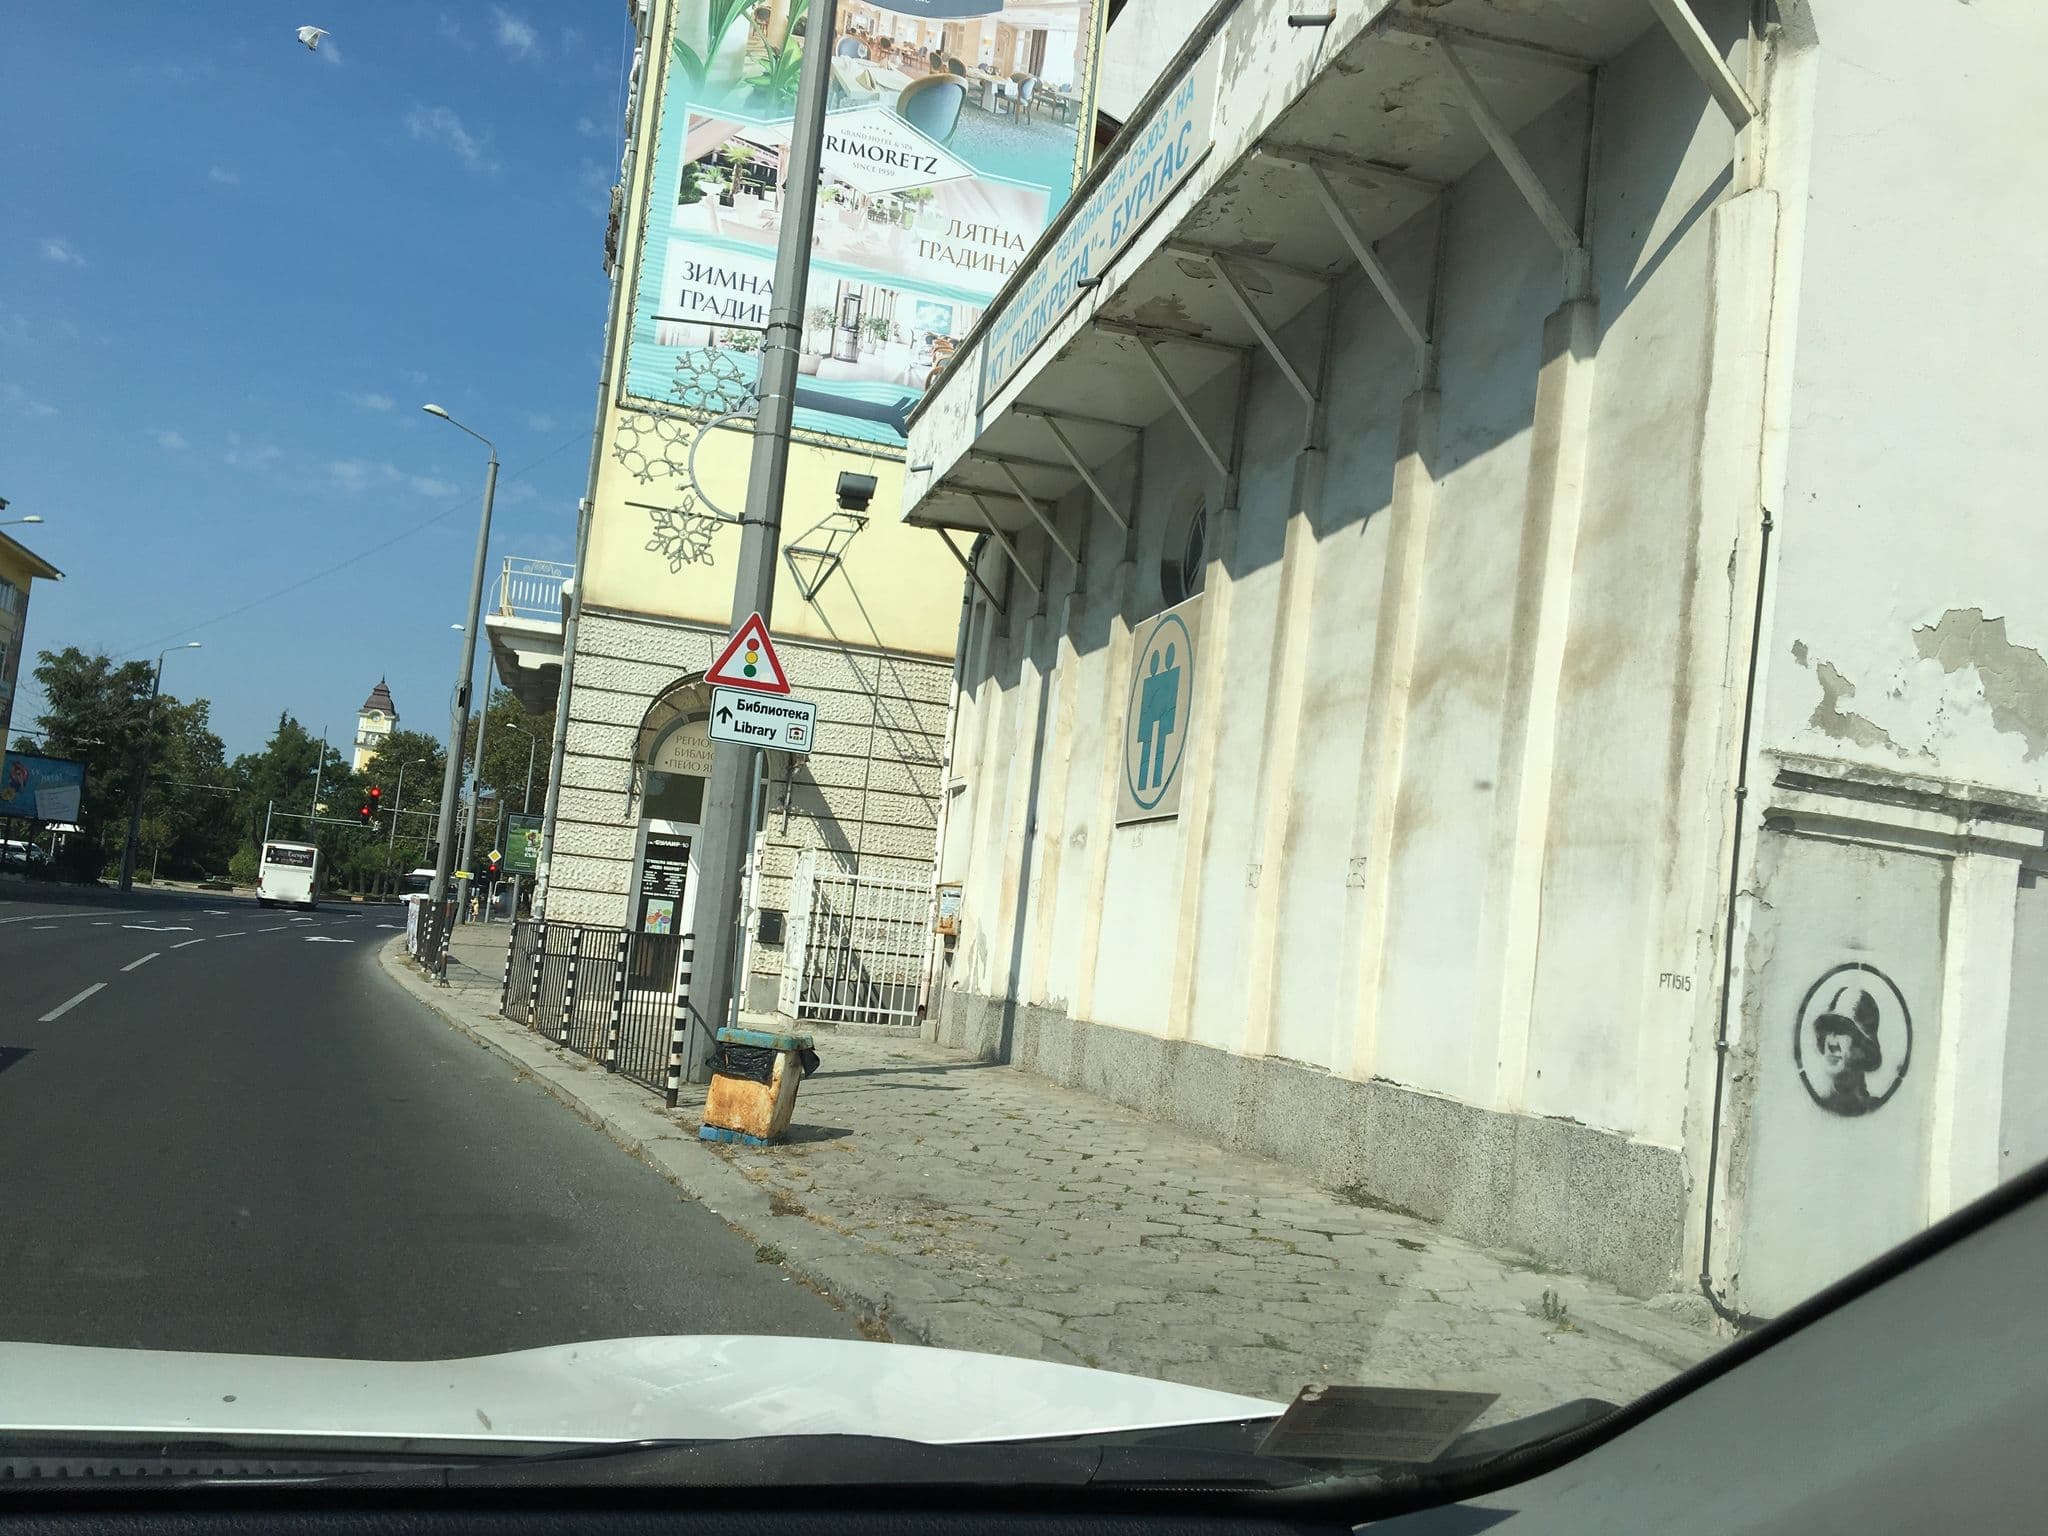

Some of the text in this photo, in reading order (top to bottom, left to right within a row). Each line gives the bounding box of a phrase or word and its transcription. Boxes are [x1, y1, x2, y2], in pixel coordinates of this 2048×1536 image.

[840, 128, 868, 141] GRAND
[868, 133, 892, 146] HOTEL
[900, 143, 913, 151] SPA
[1129, 109, 1169, 177] СЪЮЗ
[1174, 78, 1196, 121] НА
[825, 135, 938, 175] RIMORETZ
[852, 162, 895, 177] SINCE 1959
[1110, 120, 1192, 249] БУРГАС
[945, 219, 1025, 252] ЛЯТНА
[682, 260, 774, 295] ЗИМНА
[680, 289, 770, 323] ГРАДИН
[737, 698, 810, 721] Библиотека
[676, 735, 712, 748] РЕГИО
[734, 720, 777, 740] Library
[669, 758, 701, 771] ПЕЙО
